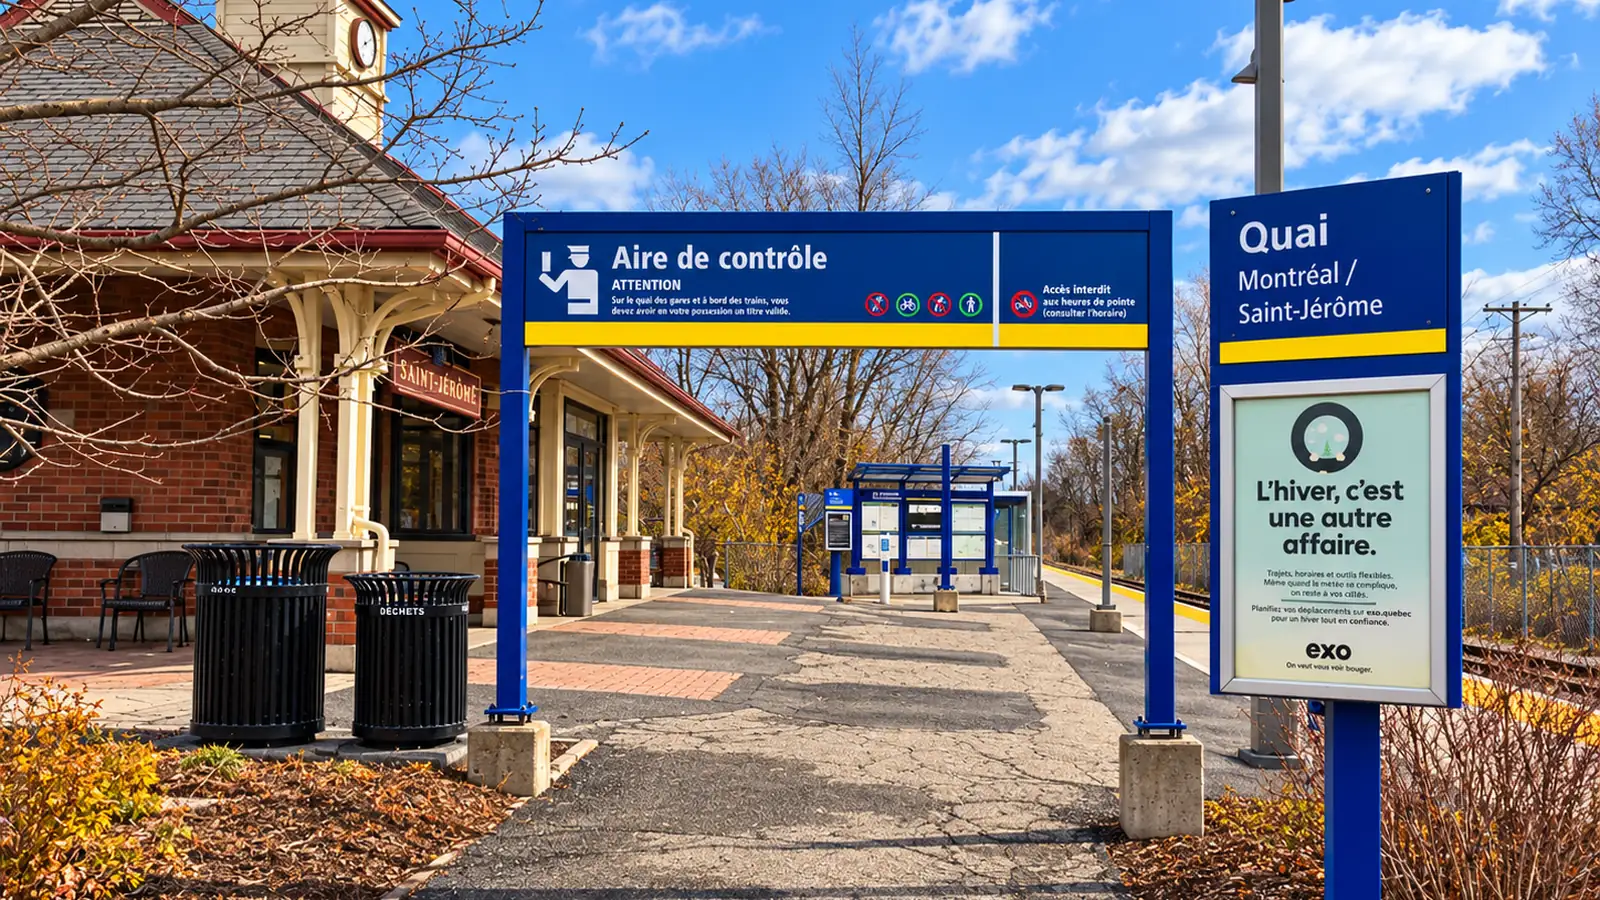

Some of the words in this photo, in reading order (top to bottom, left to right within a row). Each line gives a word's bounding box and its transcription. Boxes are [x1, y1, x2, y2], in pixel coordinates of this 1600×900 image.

[1240, 213, 1327, 253] Quai
[612, 245, 667, 269] Aire
[678, 245, 709, 269] de
[719, 245, 827, 269] contrôle
[1240, 261, 1338, 291] Montréal
[1346, 259, 1357, 286] /
[612, 279, 680, 290] ATTENTION
[1043, 284, 1070, 294] Accès
[1074, 285, 1110, 294] interdit
[612, 296, 624, 304] Sur
[627, 296, 633, 304] le
[636, 296, 652, 307] quai
[654, 296, 667, 304] des
[703, 296, 707, 304] à
[1062, 297, 1091, 306] heures
[1093, 297, 1104, 306] de
[1107, 297, 1135, 308] pointe
[1239, 296, 1382, 324] Saint-Jérôme
[1043, 308, 1086, 317] (consulter
[1258, 480, 1340, 504] L’hiver,
[1346, 480, 1404, 500] c’est
[1269, 512, 1314, 527] une
[1322, 508, 1392, 528] autre
[1283, 533, 1376, 555] affaire.
[1306, 643, 1351, 660] exo
[1346, 666, 1372, 674] bouger.
